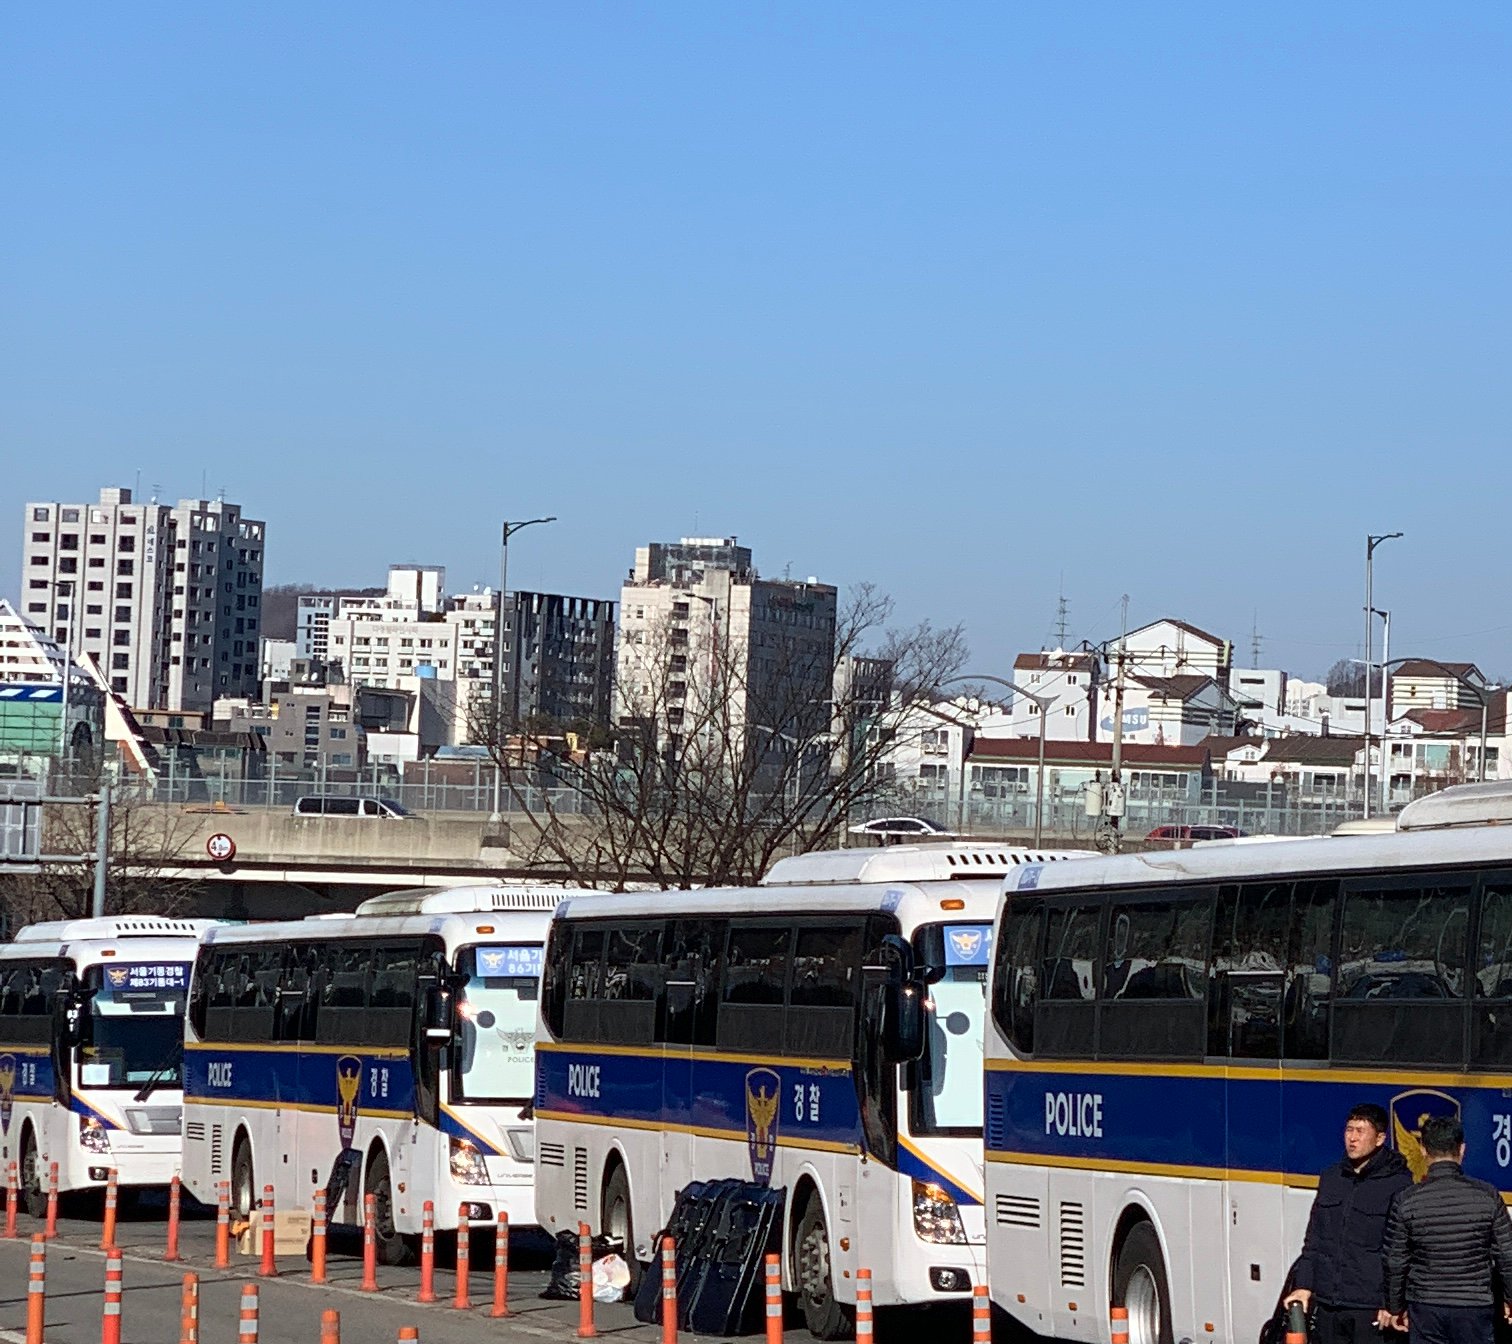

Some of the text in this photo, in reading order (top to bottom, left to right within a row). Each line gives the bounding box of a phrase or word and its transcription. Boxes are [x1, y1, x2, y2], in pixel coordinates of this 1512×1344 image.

[130, 966, 184, 977] 서울기동경찰
[508, 963, 541, 975] 86기
[208, 1062, 232, 1087] POLICE
[568, 1064, 600, 1097] POLICE
[794, 1083, 820, 1122] 경찰
[1045, 1092, 1102, 1137] POLICE
